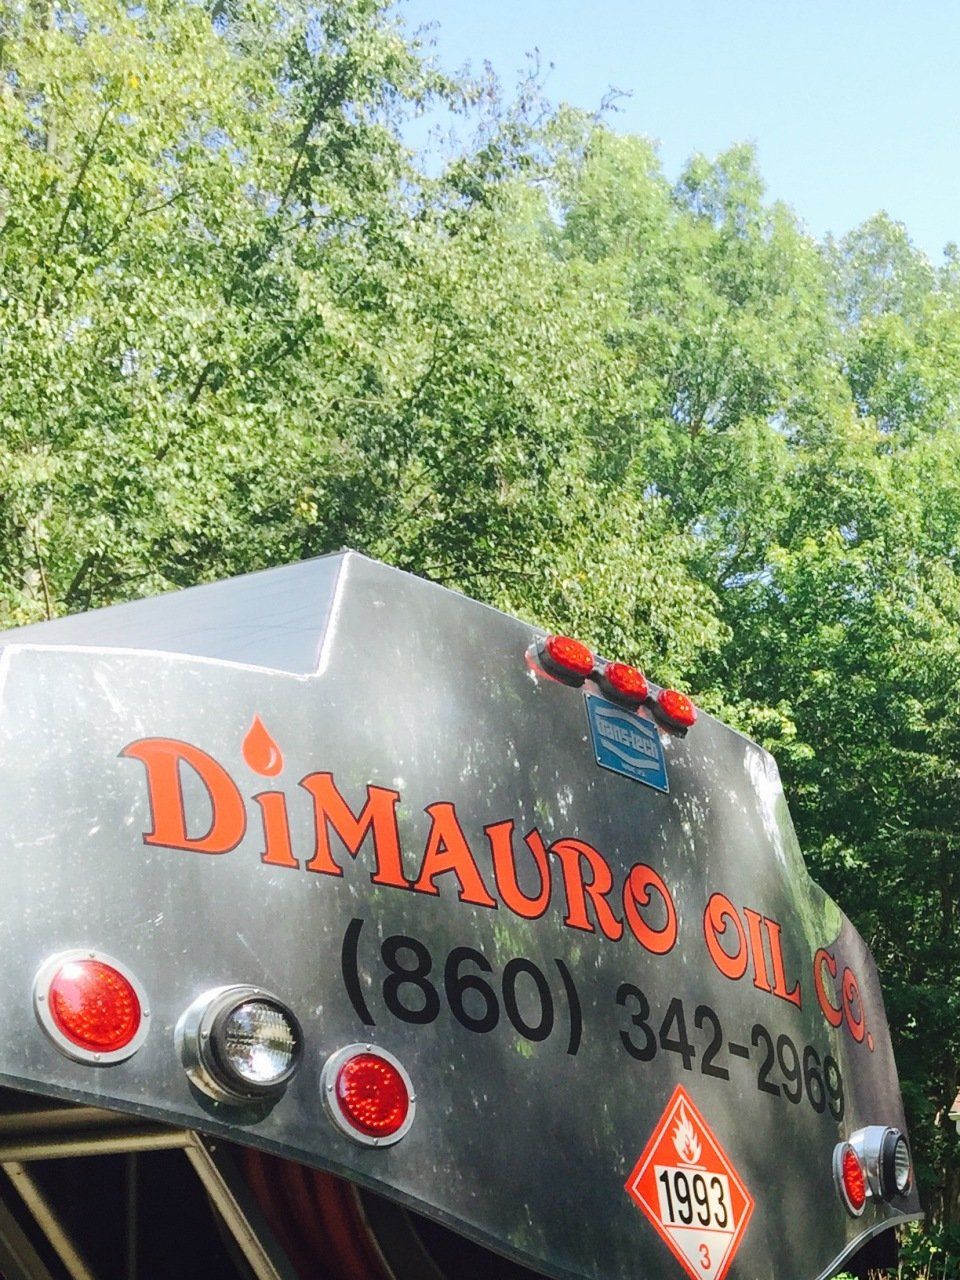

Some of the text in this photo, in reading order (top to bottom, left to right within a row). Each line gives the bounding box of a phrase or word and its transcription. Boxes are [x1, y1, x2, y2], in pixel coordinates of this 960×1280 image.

[117, 712, 874, 1053] DiMAURO OIL CO.
[341, 918, 845, 1122] (860) 342-2969
[659, 1169, 728, 1270] 1993 3
